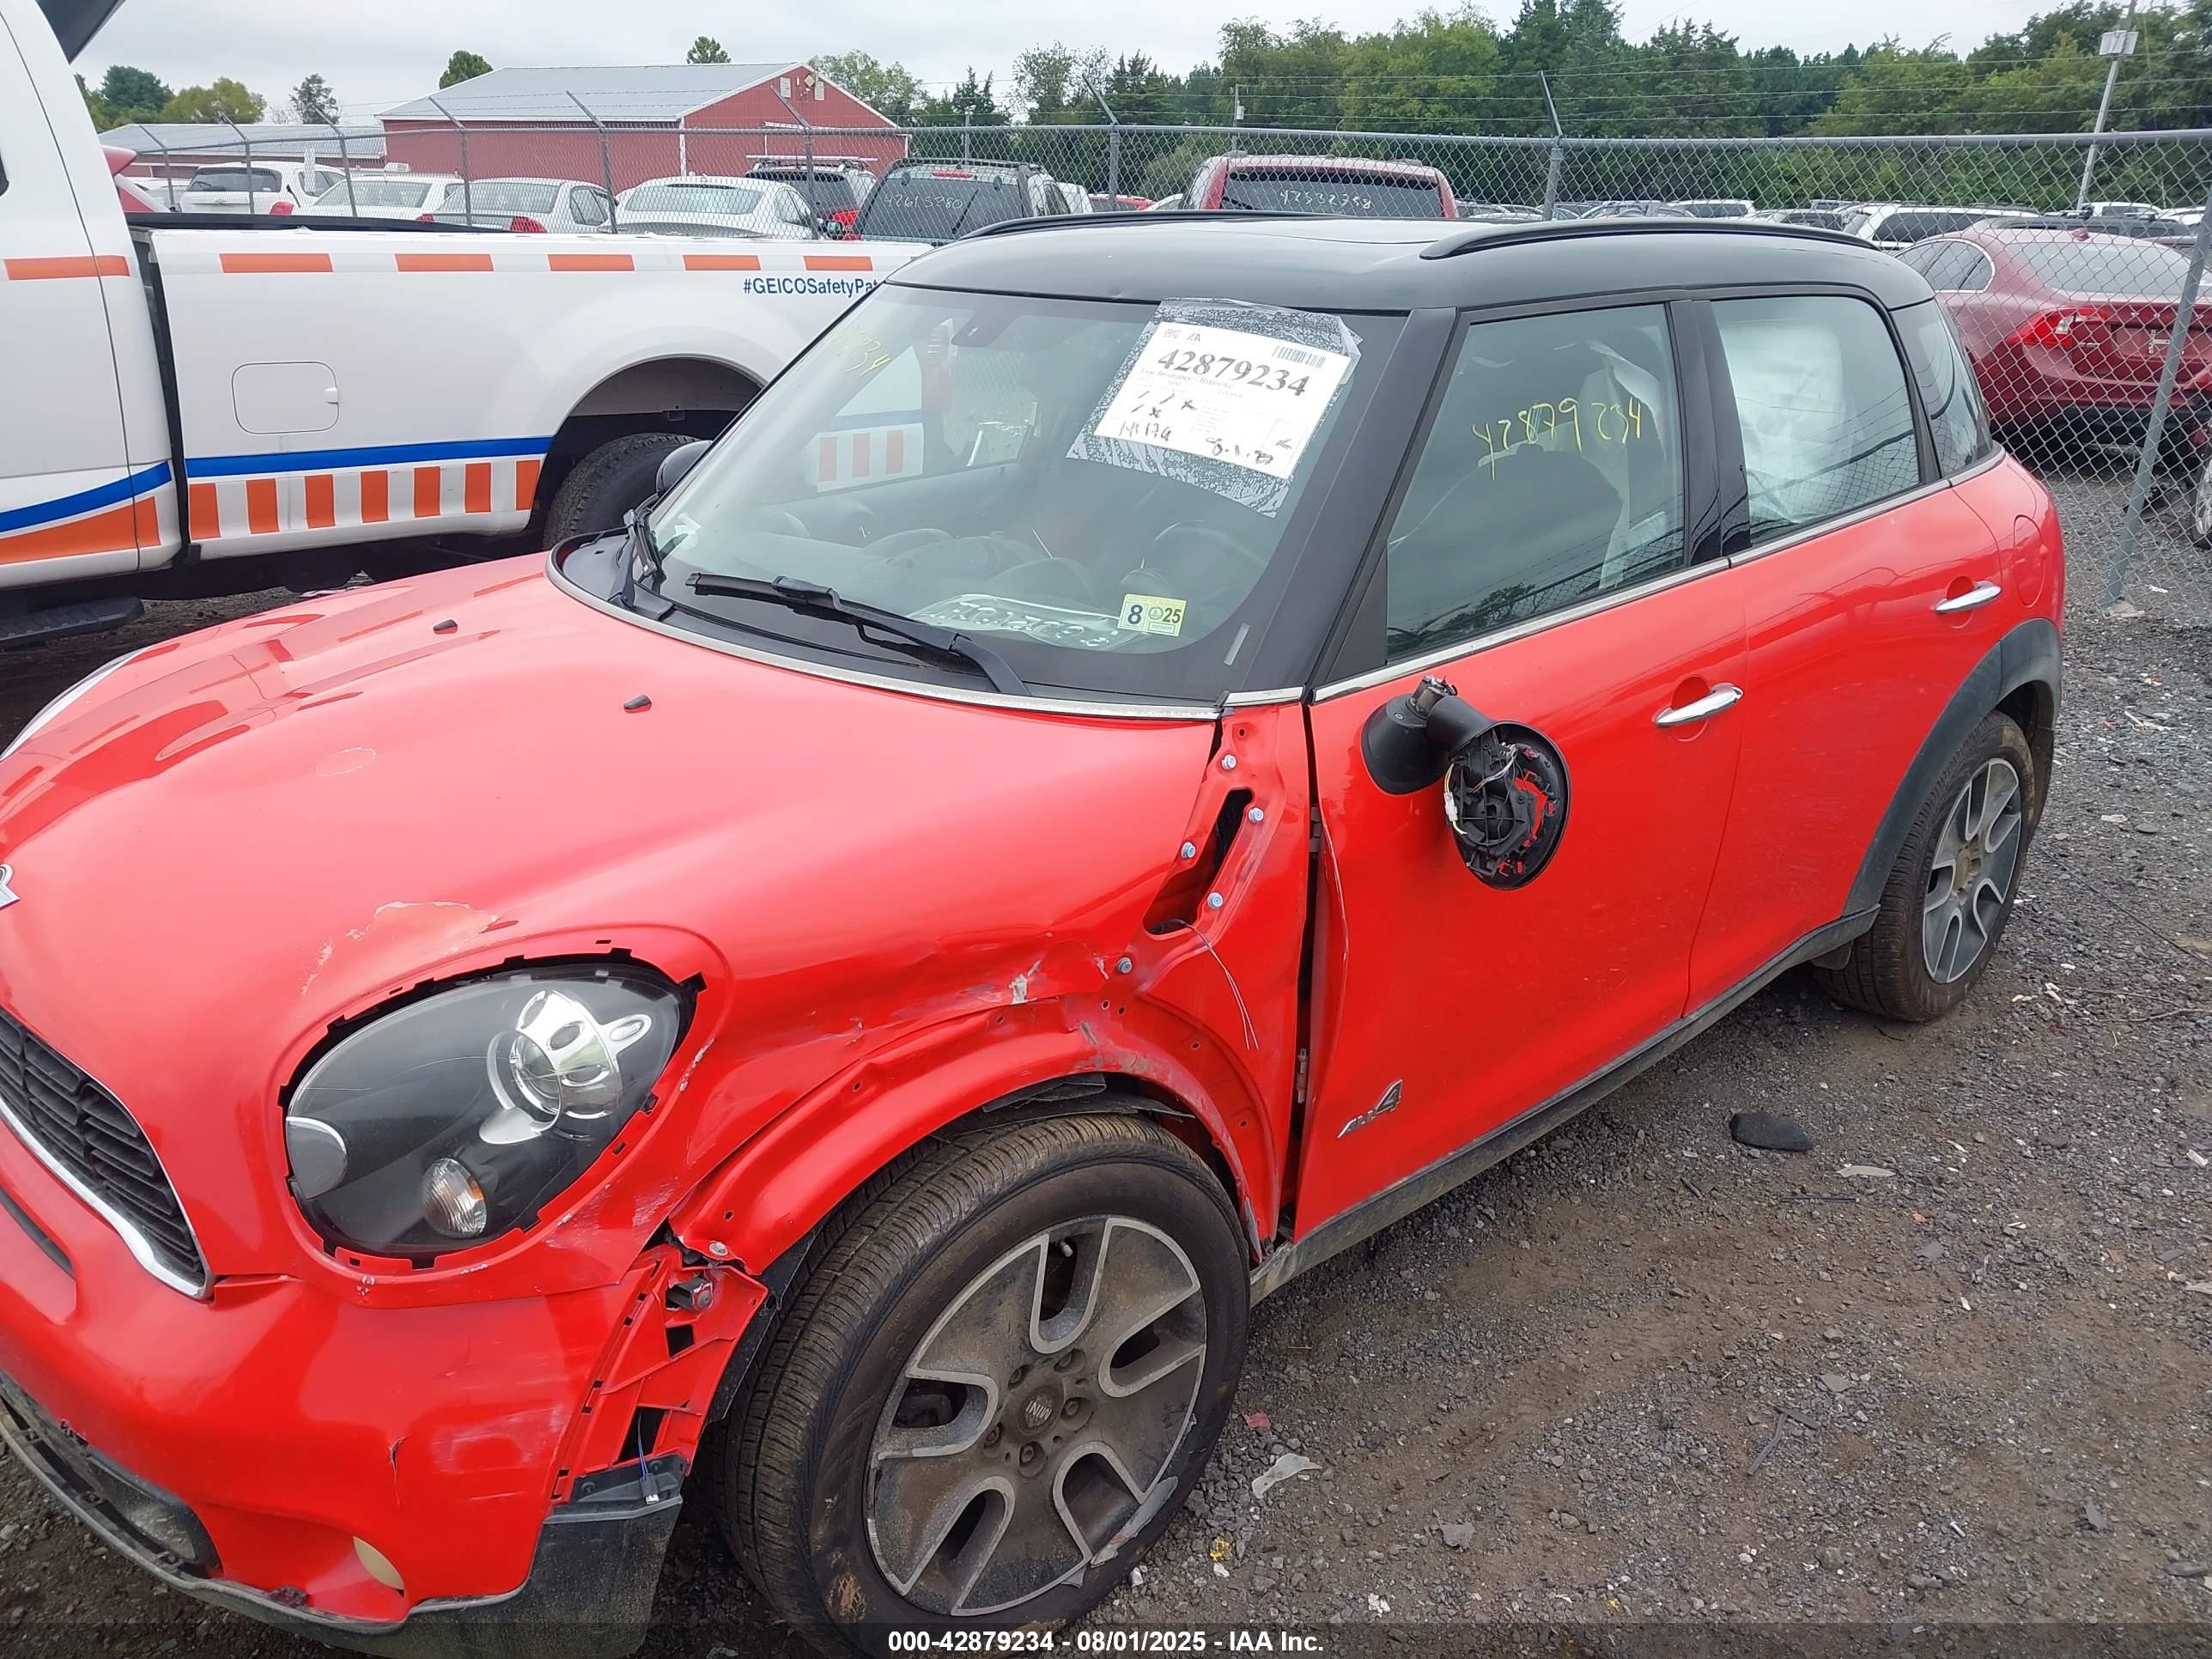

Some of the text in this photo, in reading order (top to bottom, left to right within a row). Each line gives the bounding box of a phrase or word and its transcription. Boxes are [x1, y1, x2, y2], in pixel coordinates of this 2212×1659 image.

[1158, 348, 1311, 397] 42879234
[1127, 604, 1144, 625] 8
[1162, 607, 1182, 623] 25
[1024, 1400, 1053, 1421] MINI
